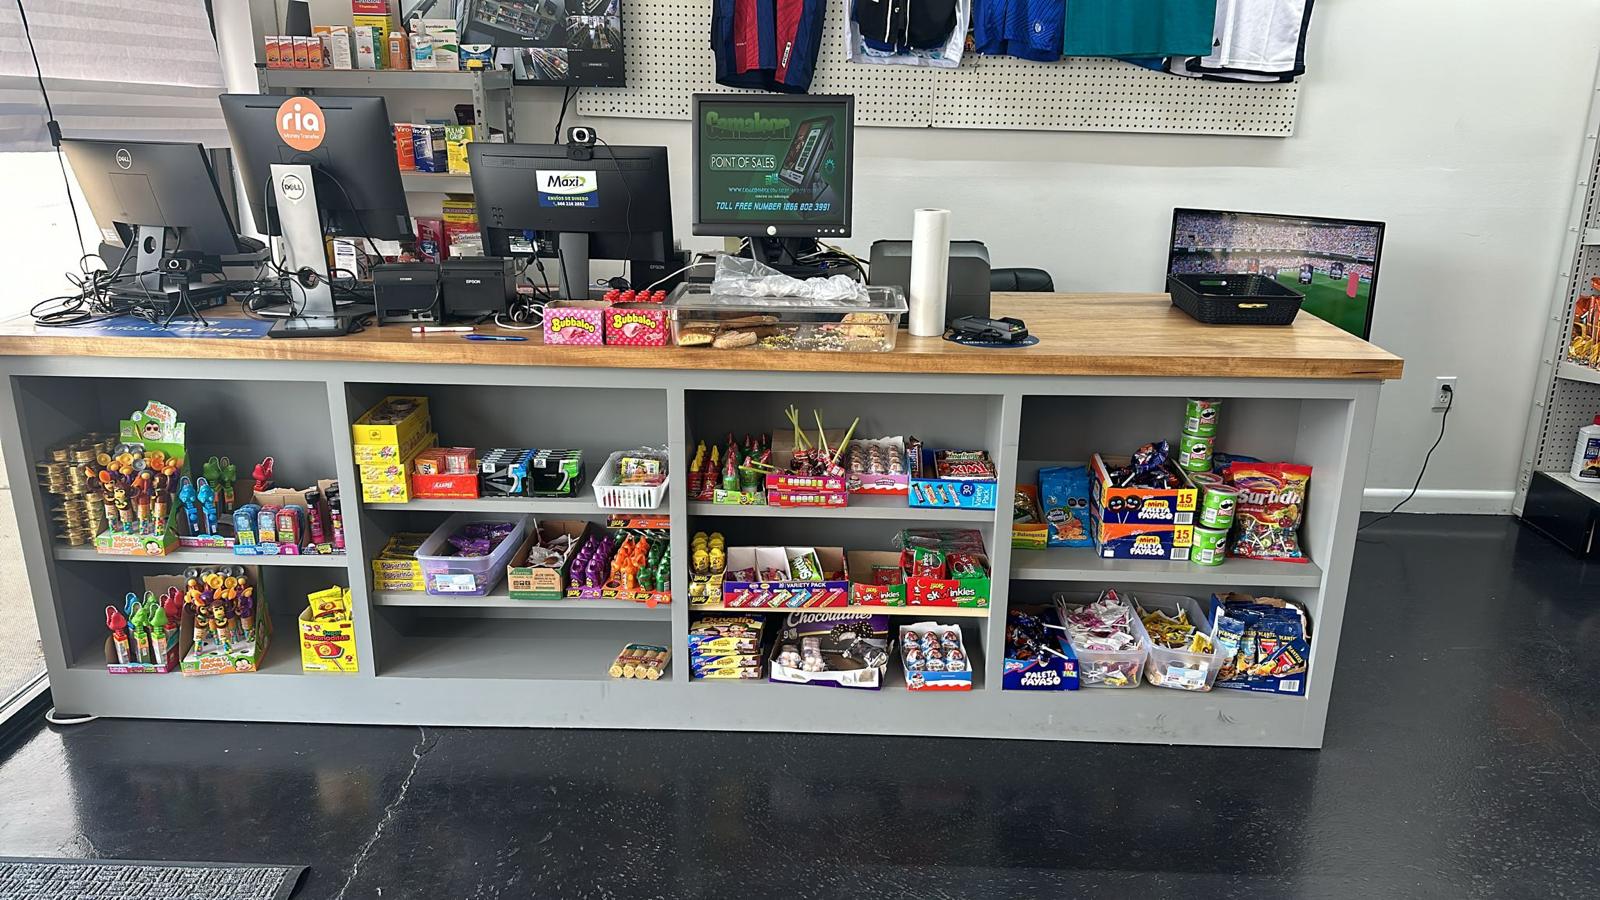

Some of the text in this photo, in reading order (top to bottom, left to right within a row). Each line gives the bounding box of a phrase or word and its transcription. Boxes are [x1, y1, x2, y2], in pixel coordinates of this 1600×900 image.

[282, 103, 319, 131] ria
[711, 156, 775, 169] POINT OF SALES
[547, 175, 579, 187] Maxi
[716, 202, 830, 211] TOLL FREE NUMBER 1866 802 3991
[551, 316, 595, 333] Bubbaloo
[613, 313, 656, 329] Bubbaloo
[950, 461, 990, 475] TWIX
[975, 486, 984, 507] Variety
[982, 489, 990, 504] Pack
[1179, 494, 1193, 504] 15
[1138, 511, 1173, 520] PAYASO
[1176, 529, 1190, 540] 15
[1130, 548, 1165, 556] PAYASO
[783, 631, 788, 639] 9
[1025, 670, 1057, 679] PALETA
[1021, 676, 1061, 686] PAYASO
